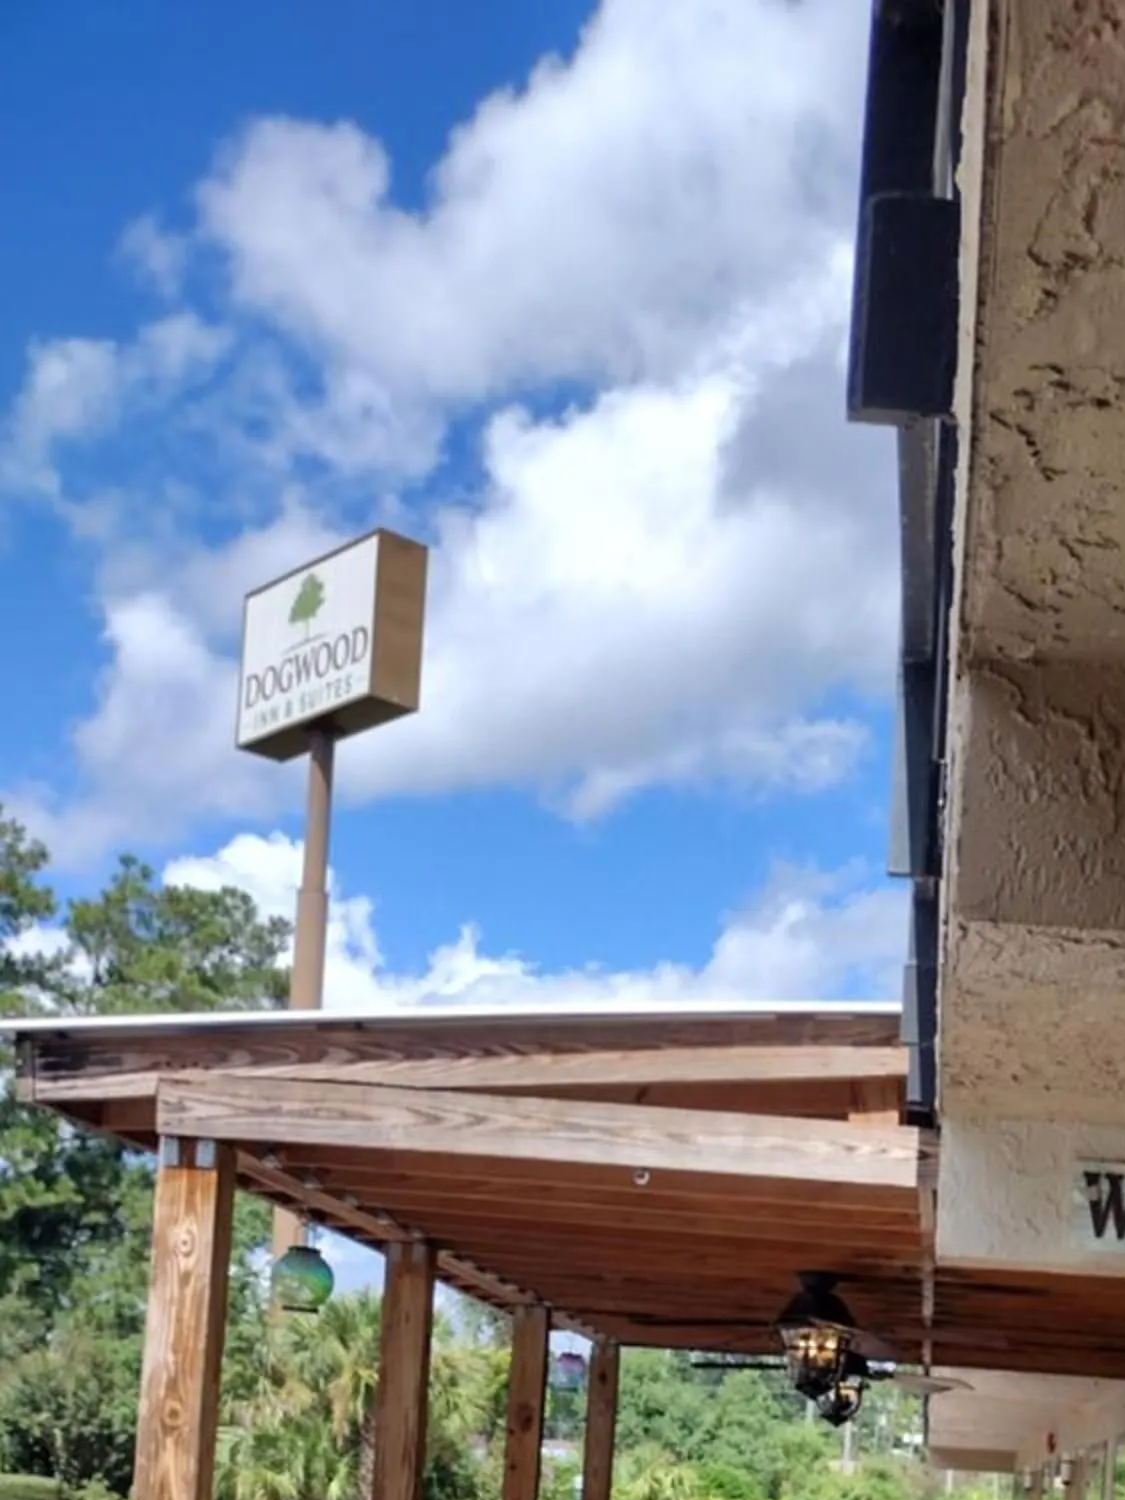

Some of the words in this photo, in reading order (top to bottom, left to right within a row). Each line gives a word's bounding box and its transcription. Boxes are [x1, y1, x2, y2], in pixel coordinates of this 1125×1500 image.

[245, 625, 369, 709] DOGWOOD
[253, 704, 278, 729] INN
[300, 676, 352, 713] SUITES
